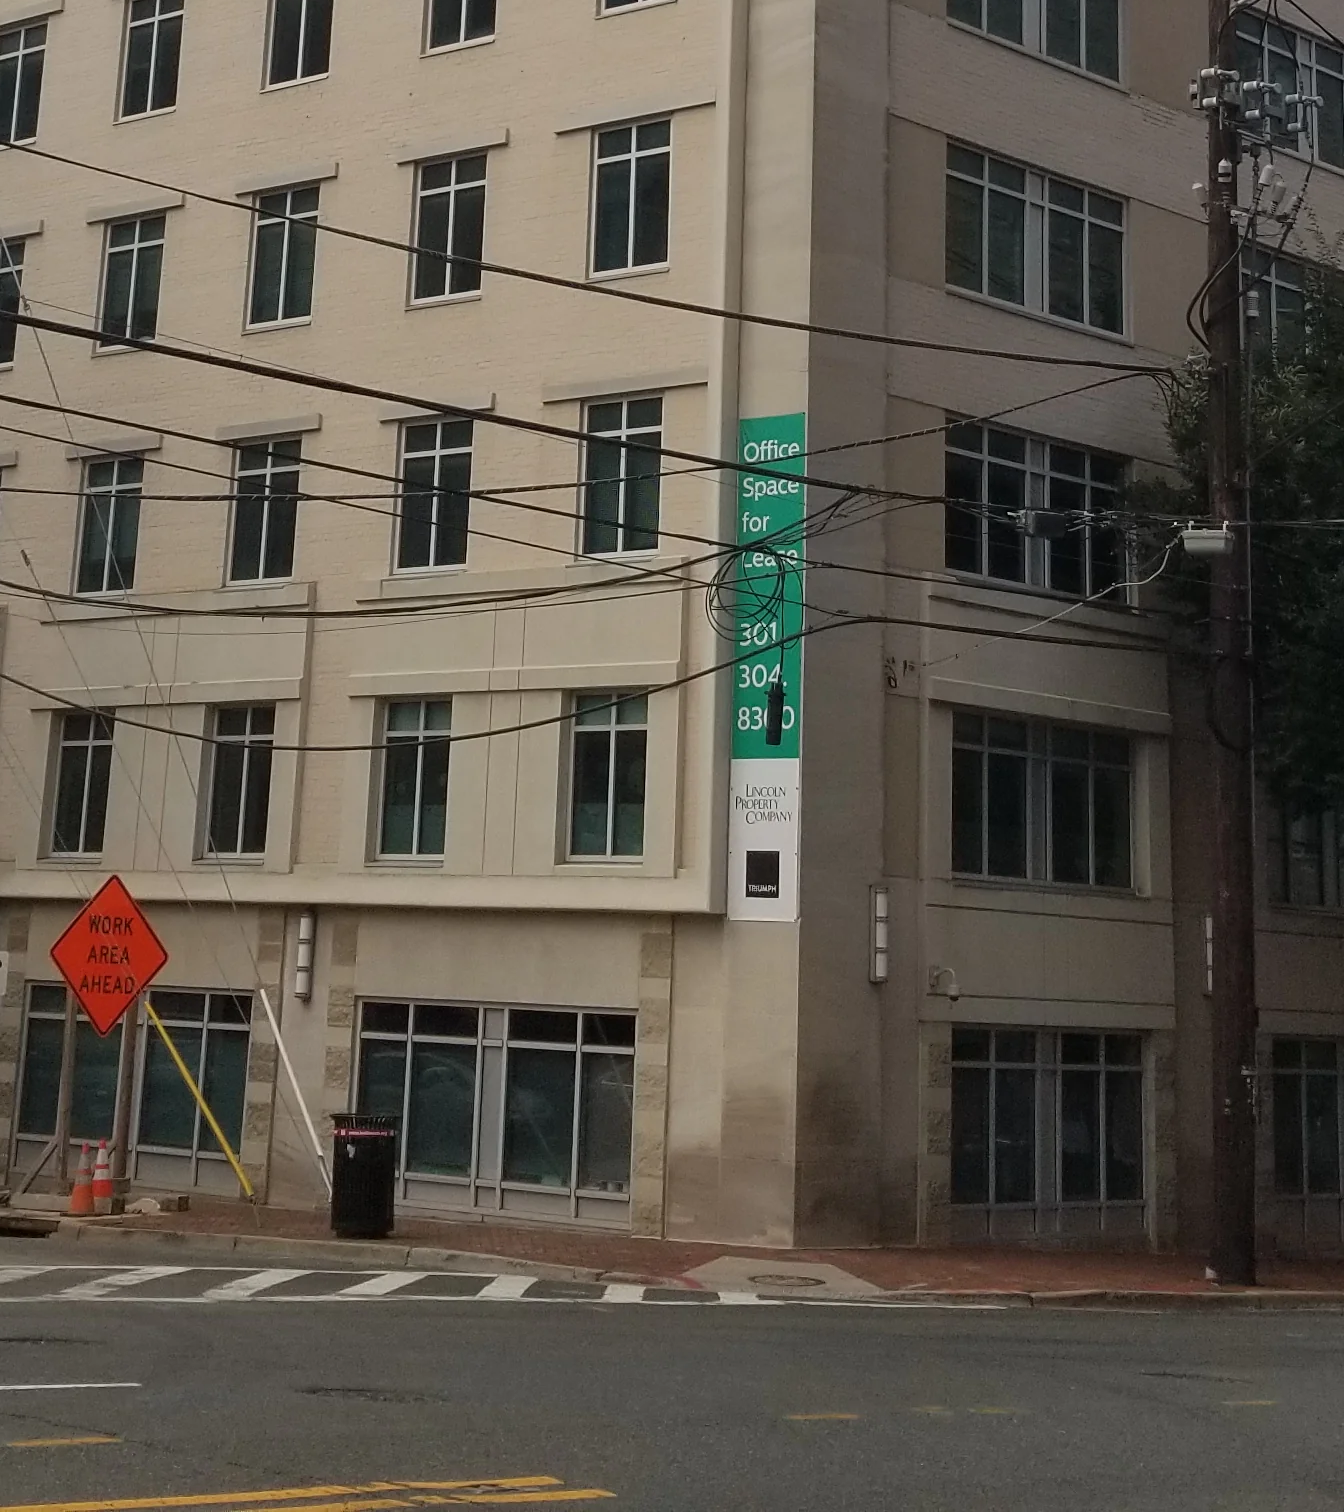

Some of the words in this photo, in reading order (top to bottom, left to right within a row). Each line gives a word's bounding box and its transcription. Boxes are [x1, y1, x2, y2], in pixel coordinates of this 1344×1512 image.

[743, 440, 799, 462] Office
[742, 478, 799, 501] Space
[742, 512, 770, 532] for
[741, 548, 798, 568] Leae
[746, 784, 786, 797] LINCOLN
[735, 796, 779, 810] PROPERTY
[746, 811, 792, 824] COMPANY
[89, 915, 134, 935] WORK
[87, 945, 130, 965] AREA
[79, 975, 136, 995] AHEAD
